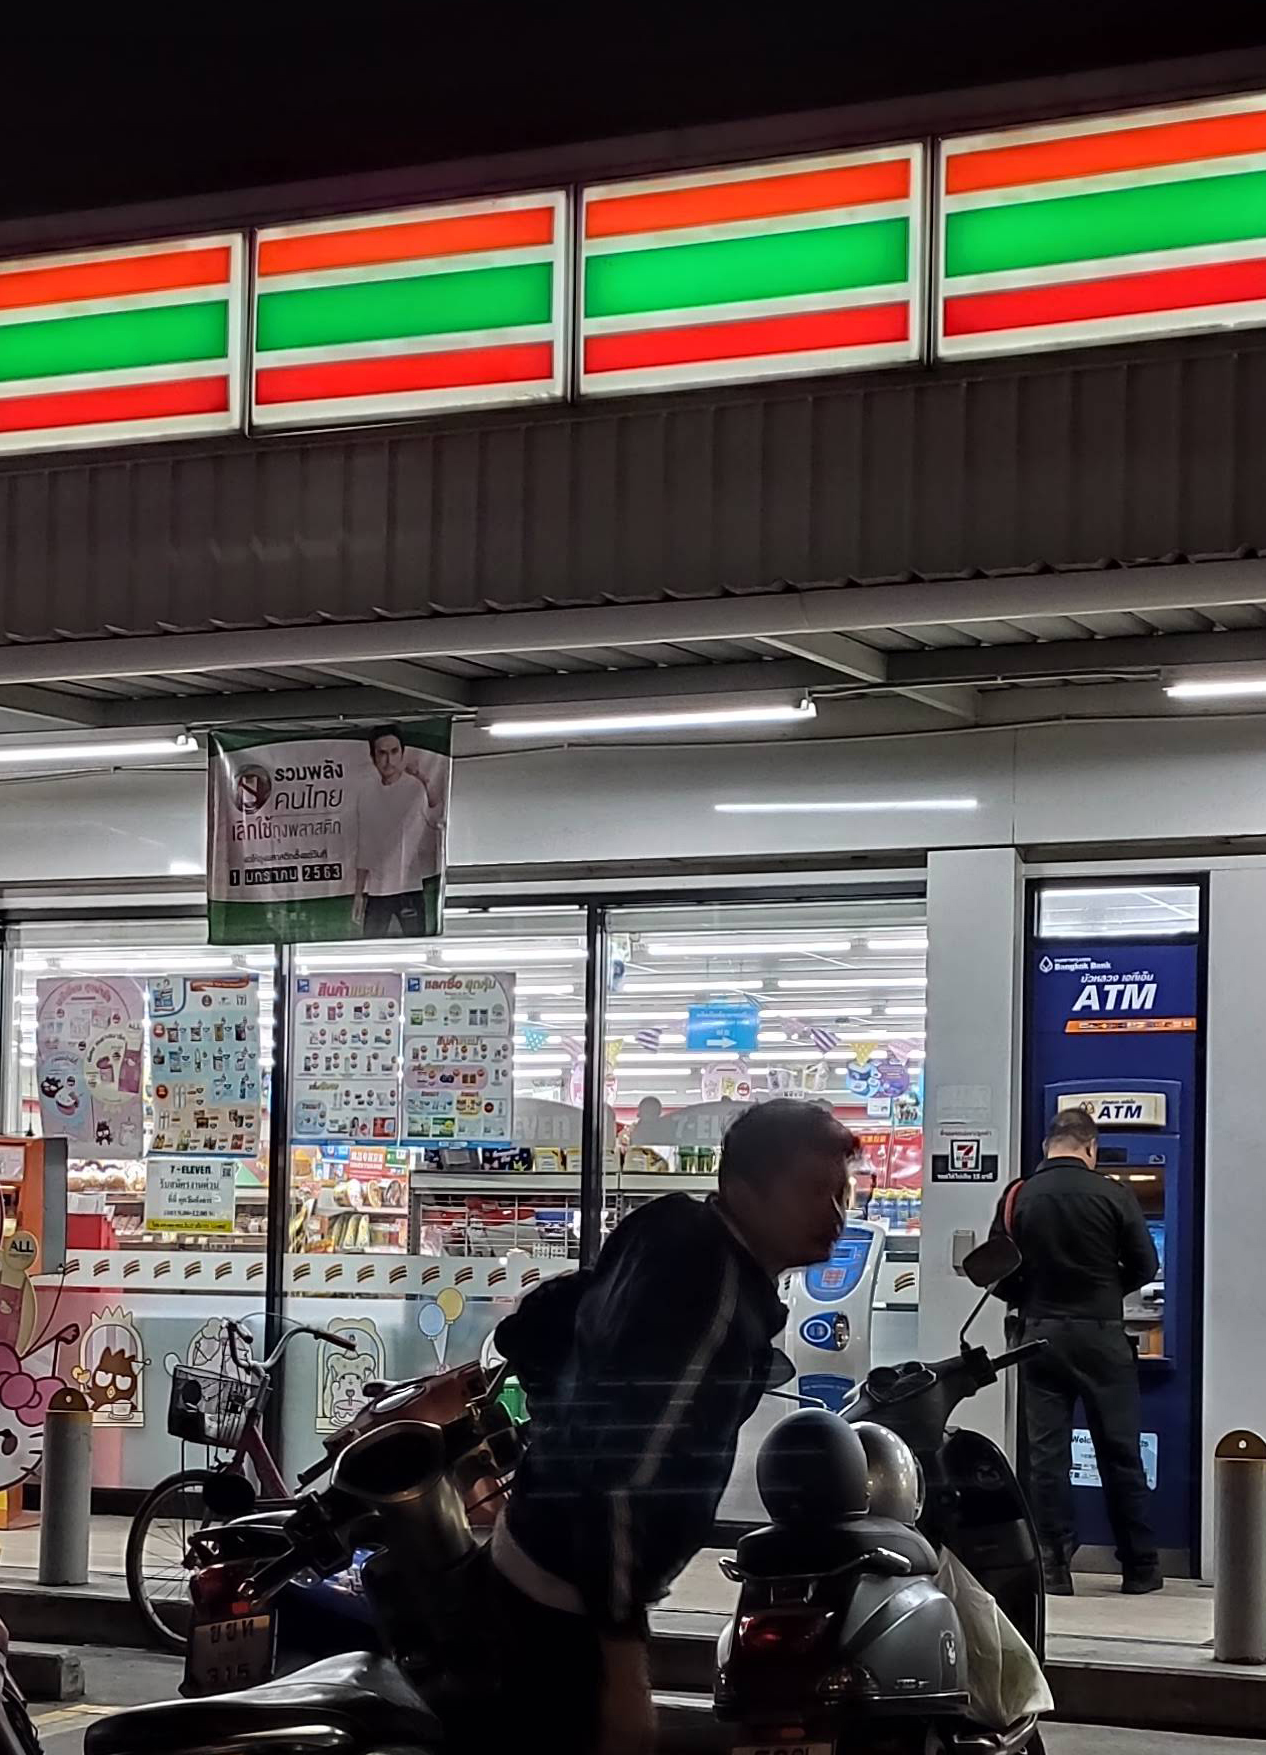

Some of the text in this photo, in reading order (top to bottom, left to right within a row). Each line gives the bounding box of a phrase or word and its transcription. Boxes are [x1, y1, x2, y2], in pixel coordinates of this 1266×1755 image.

[274, 758, 343, 782] รวมพลัง
[275, 784, 343, 810] คนไทย
[232, 814, 342, 844] เลิกใช้ถุงพลาสติก
[245, 868, 298, 884] มกราคม
[304, 865, 341, 881] 2563
[1054, 961, 1111, 971] Bangkok Bank
[1080, 971, 1154, 983] บัวหลวง เอทีเอ็ม
[1072, 984, 1158, 1012] ATM
[1098, 1105, 1142, 1119] ATM
[957, 1144, 974, 1169] 7
[9, 1239, 34, 1252] ALL
